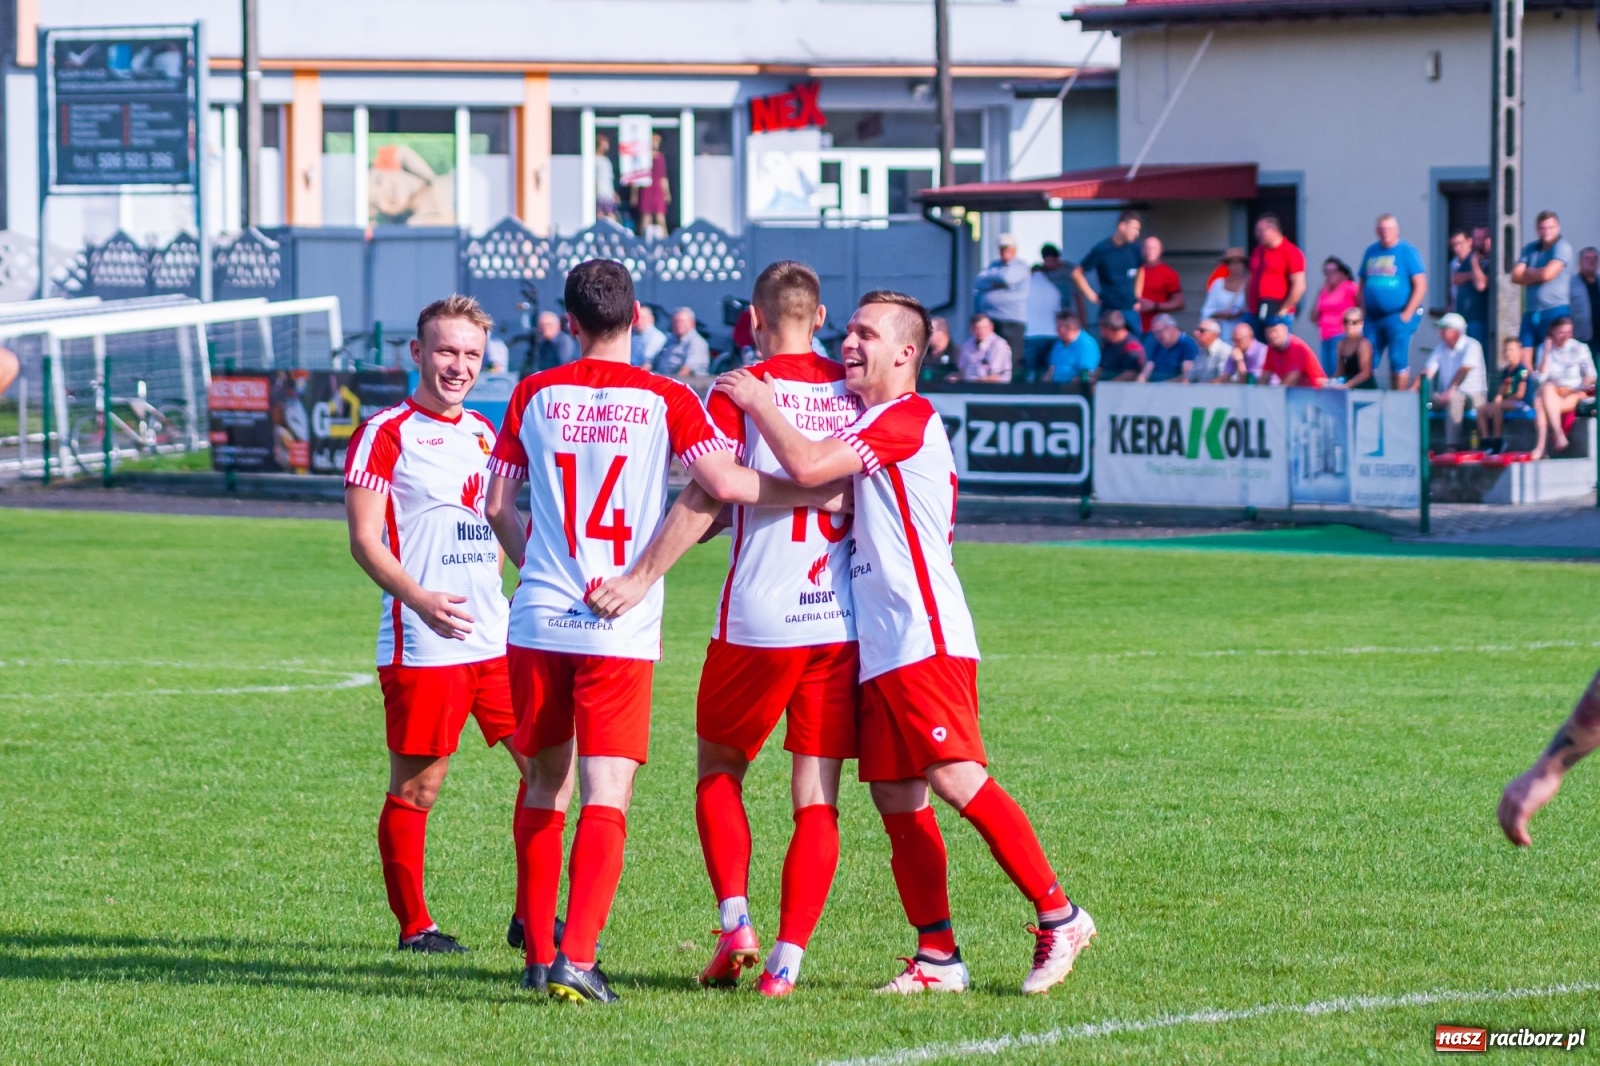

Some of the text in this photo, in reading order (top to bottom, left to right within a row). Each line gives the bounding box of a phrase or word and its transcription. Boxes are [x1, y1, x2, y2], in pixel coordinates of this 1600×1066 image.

[774, 392, 800, 409] LKS
[546, 402, 649, 425] LKS ZAMECZEK
[795, 413, 851, 432] CZERNICA
[562, 424, 628, 444] CZERNICA
[1110, 407, 1272, 460] KERAKOLL
[555, 452, 632, 566] 14
[441, 553, 483, 566] GALERIA
[850, 562, 872, 580] IEPŁA
[799, 590, 835, 605] Husar
[548, 618, 614, 631] GALERIA CIEPŁA
[785, 609, 852, 623] GALERIA CIEPŁA
